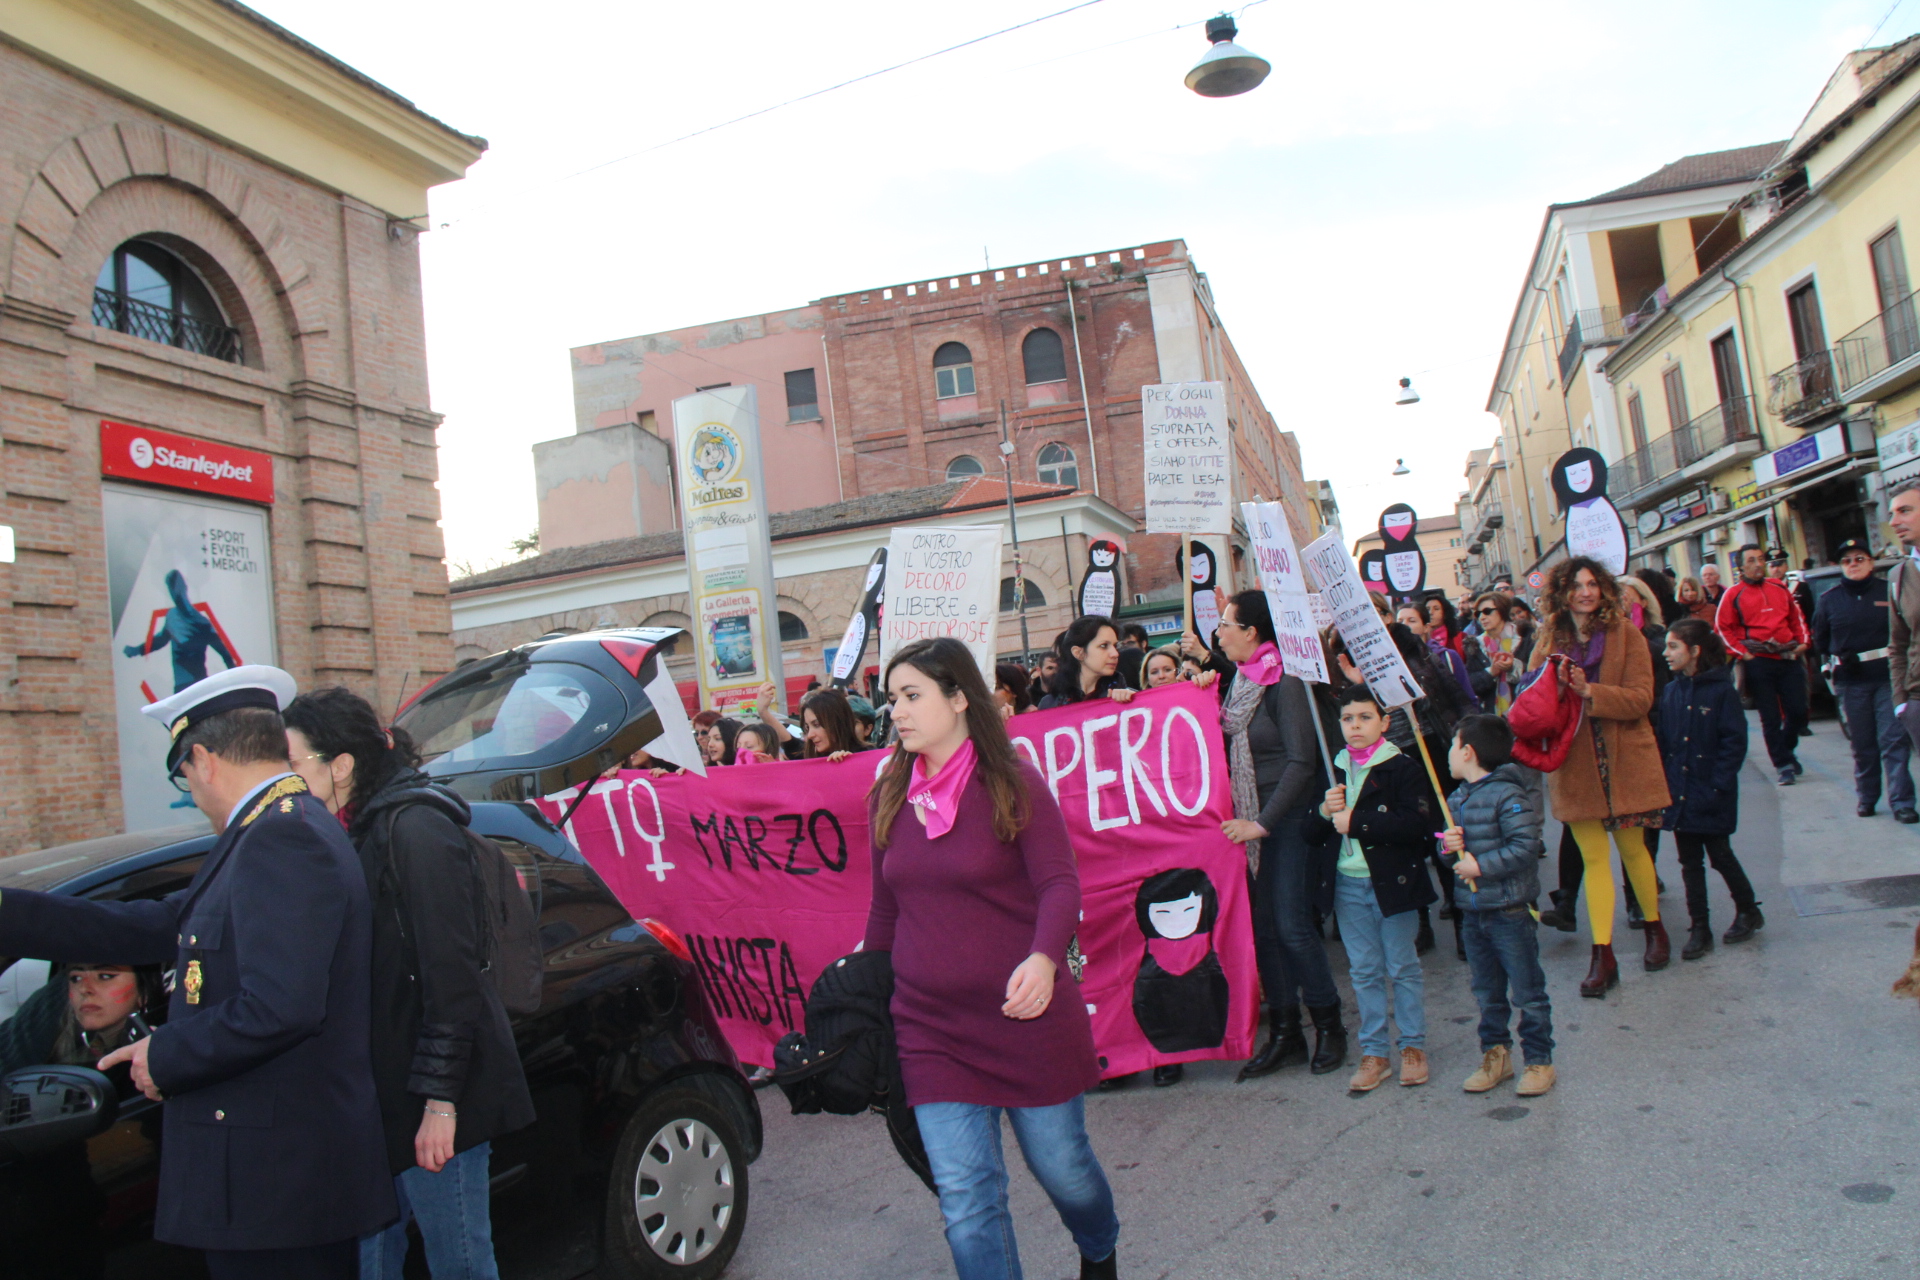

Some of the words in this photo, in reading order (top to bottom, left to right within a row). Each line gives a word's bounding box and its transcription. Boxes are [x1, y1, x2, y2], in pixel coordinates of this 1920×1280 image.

[1147, 388, 1173, 403] PER
[1179, 388, 1213, 400] OGNI
[1164, 405, 1207, 419] DONNA
[1150, 422, 1215, 436] STUPRATA
[1154, 439, 1161, 448] E
[154, 445, 253, 482] Stanleybet
[1150, 456, 1186, 468] SIAMO
[1187, 455, 1224, 467] TUTTE
[1148, 472, 1184, 486] PARTE
[1193, 473, 1225, 486] LESA
[1570, 512, 1607, 531] SCIOPERO
[209, 529, 245, 544] SPORT
[912, 534, 956, 549] CONTRO
[211, 543, 249, 559] EVENTI
[212, 558, 257, 573] MERCATI
[904, 552, 913, 568] IL
[924, 551, 973, 569] VOSTRO
[904, 572, 967, 592] DECORO
[705, 601, 715, 611] La
[715, 595, 751, 608] Galleria
[894, 596, 960, 617] LIBERE
[968, 604, 977, 615] e
[702, 606, 758, 623] Commerciale
[544, 777, 675, 882] TTO
[689, 808, 848, 875] MARZO
[684, 934, 807, 1032] INISTA
